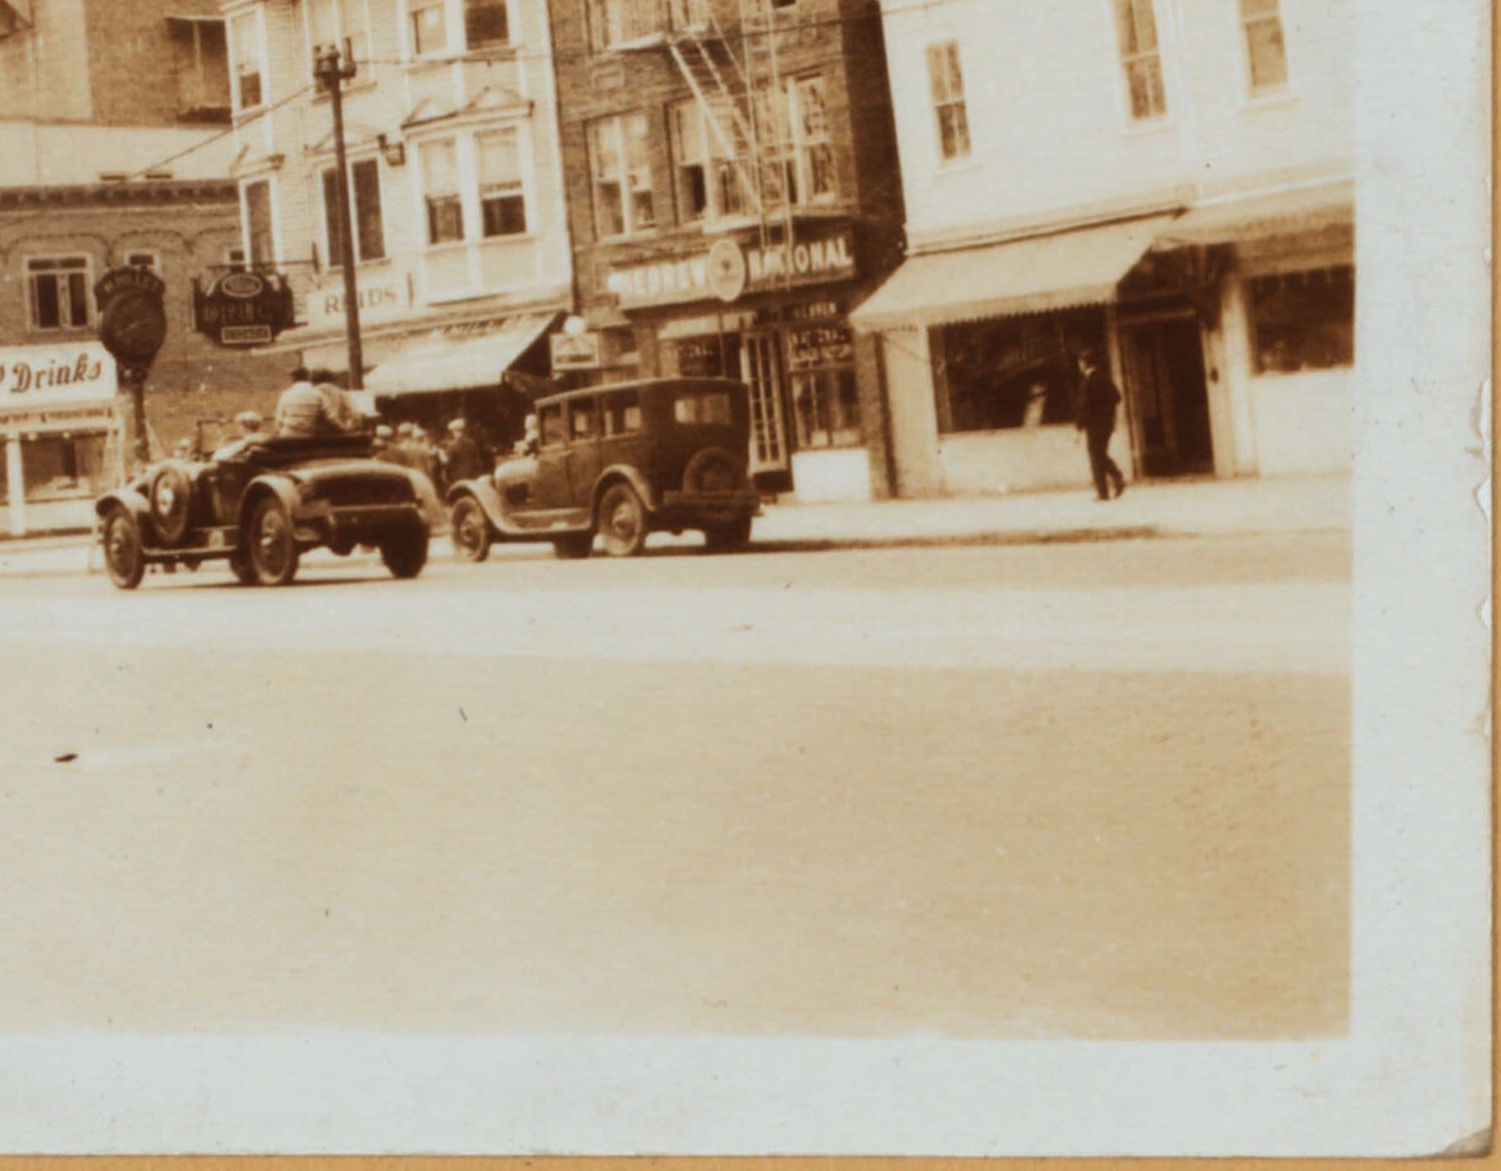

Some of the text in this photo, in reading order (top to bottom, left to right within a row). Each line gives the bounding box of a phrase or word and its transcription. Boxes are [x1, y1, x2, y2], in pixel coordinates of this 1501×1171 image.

[748, 236, 854, 281] NATIONAL
[324, 290, 398, 314] RIDS
[10, 353, 102, 394] Drinks
